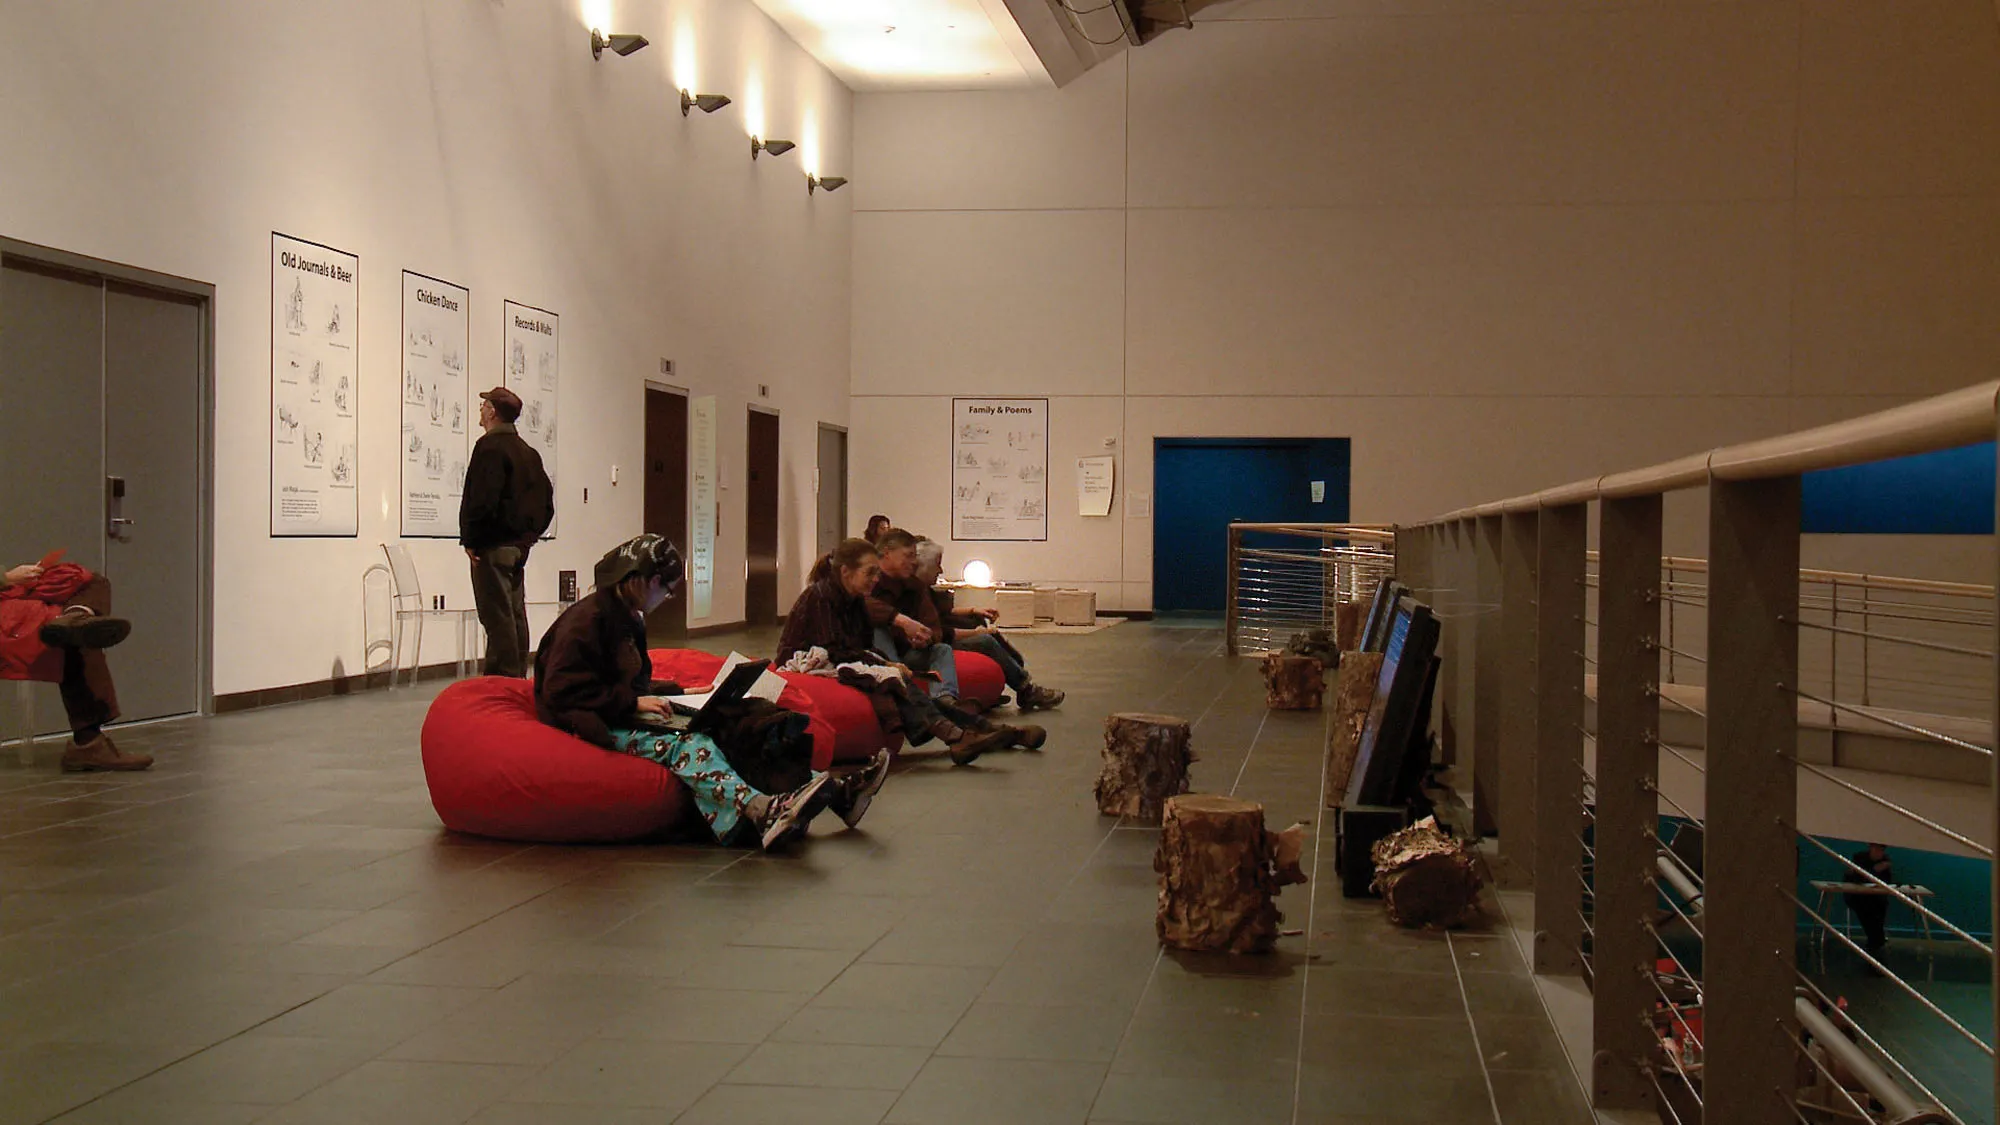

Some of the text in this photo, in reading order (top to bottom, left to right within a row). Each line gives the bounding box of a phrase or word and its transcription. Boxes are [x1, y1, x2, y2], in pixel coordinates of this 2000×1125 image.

[281, 252, 352, 283] Old Journals & Beer
[417, 289, 458, 312] Chicken Dance
[515, 316, 535, 331] Records
[536, 321, 540, 332] &
[969, 406, 1032, 416] Family & Poems
